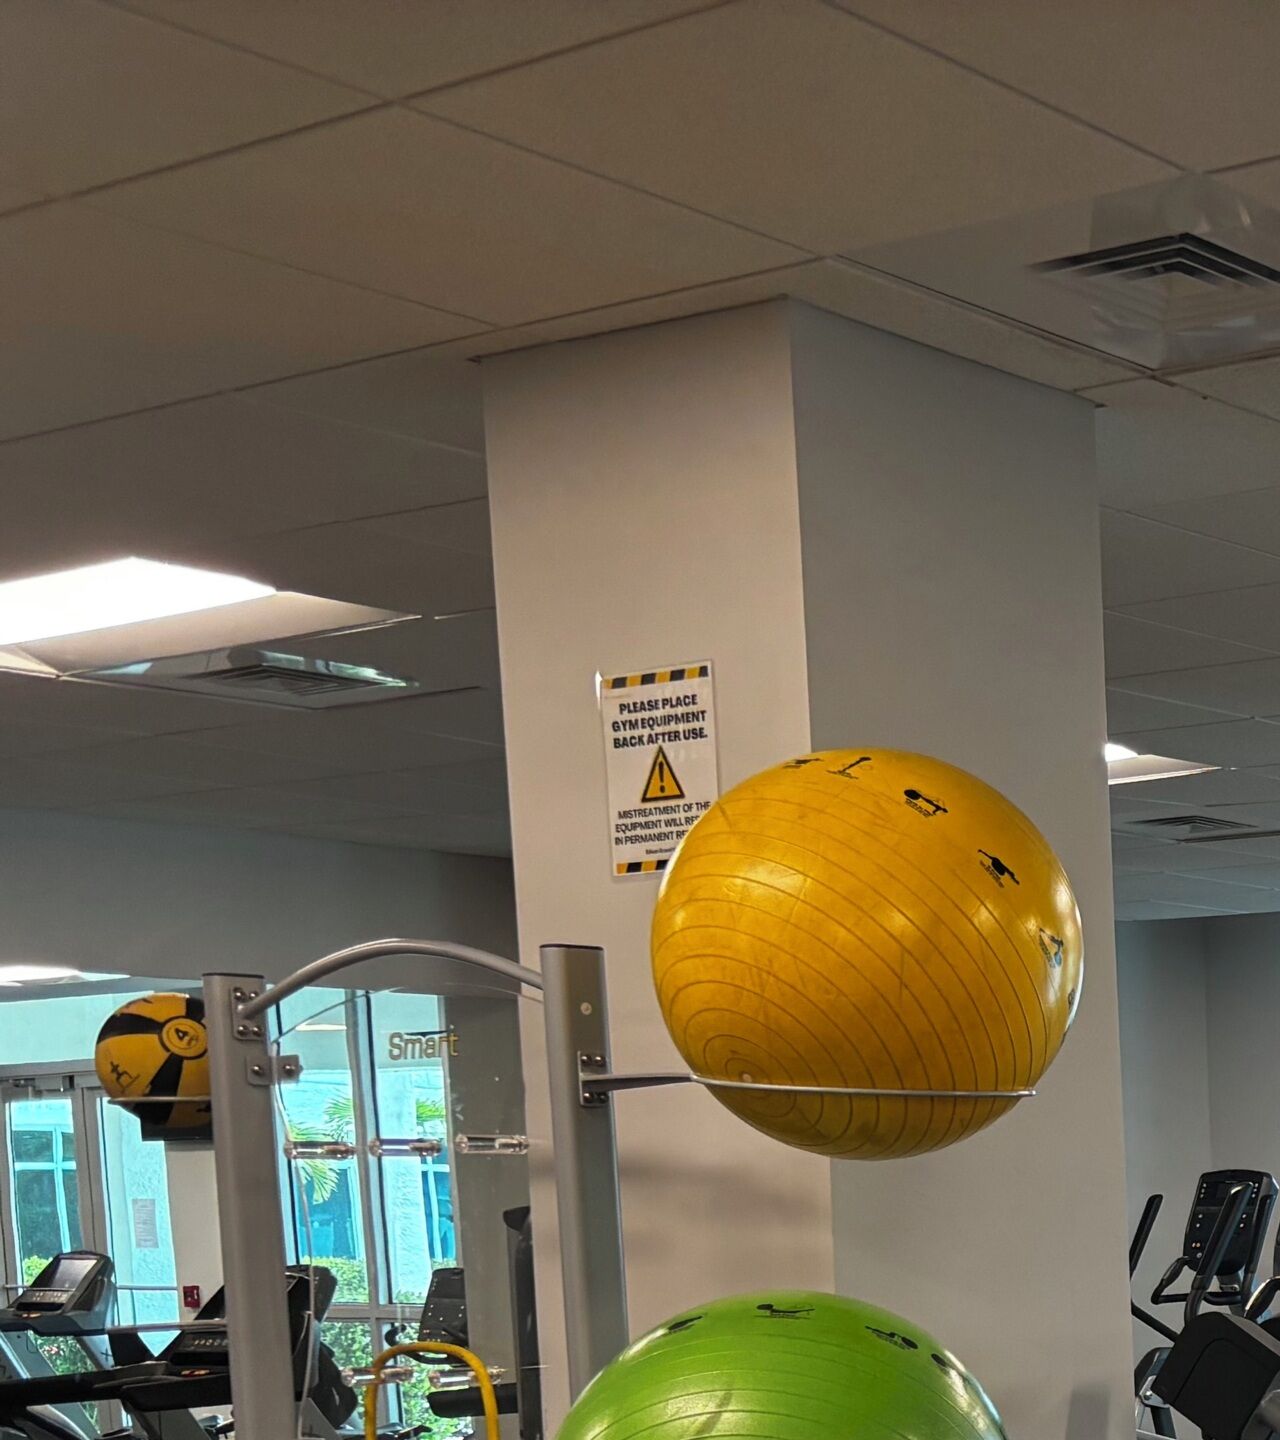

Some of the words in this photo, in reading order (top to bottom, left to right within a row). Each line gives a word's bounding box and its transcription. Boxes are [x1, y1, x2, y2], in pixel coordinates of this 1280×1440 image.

[619, 699, 660, 715] PLEASE
[661, 694, 699, 709] PLACE
[612, 718, 640, 732] GYM
[640, 710, 707, 730] EQUIPMENT
[613, 735, 646, 749] BACK
[646, 730, 682, 746] AFTER
[683, 727, 708, 740] USE.
[618, 804, 682, 820] MISTREATMENT
[682, 802, 694, 813] OF
[615, 819, 662, 834] EQUIPMENT
[664, 817, 684, 828] WILL
[615, 837, 624, 846] IN
[624, 831, 676, 845] PERMANENT
[388, 1031, 460, 1060] Smart
